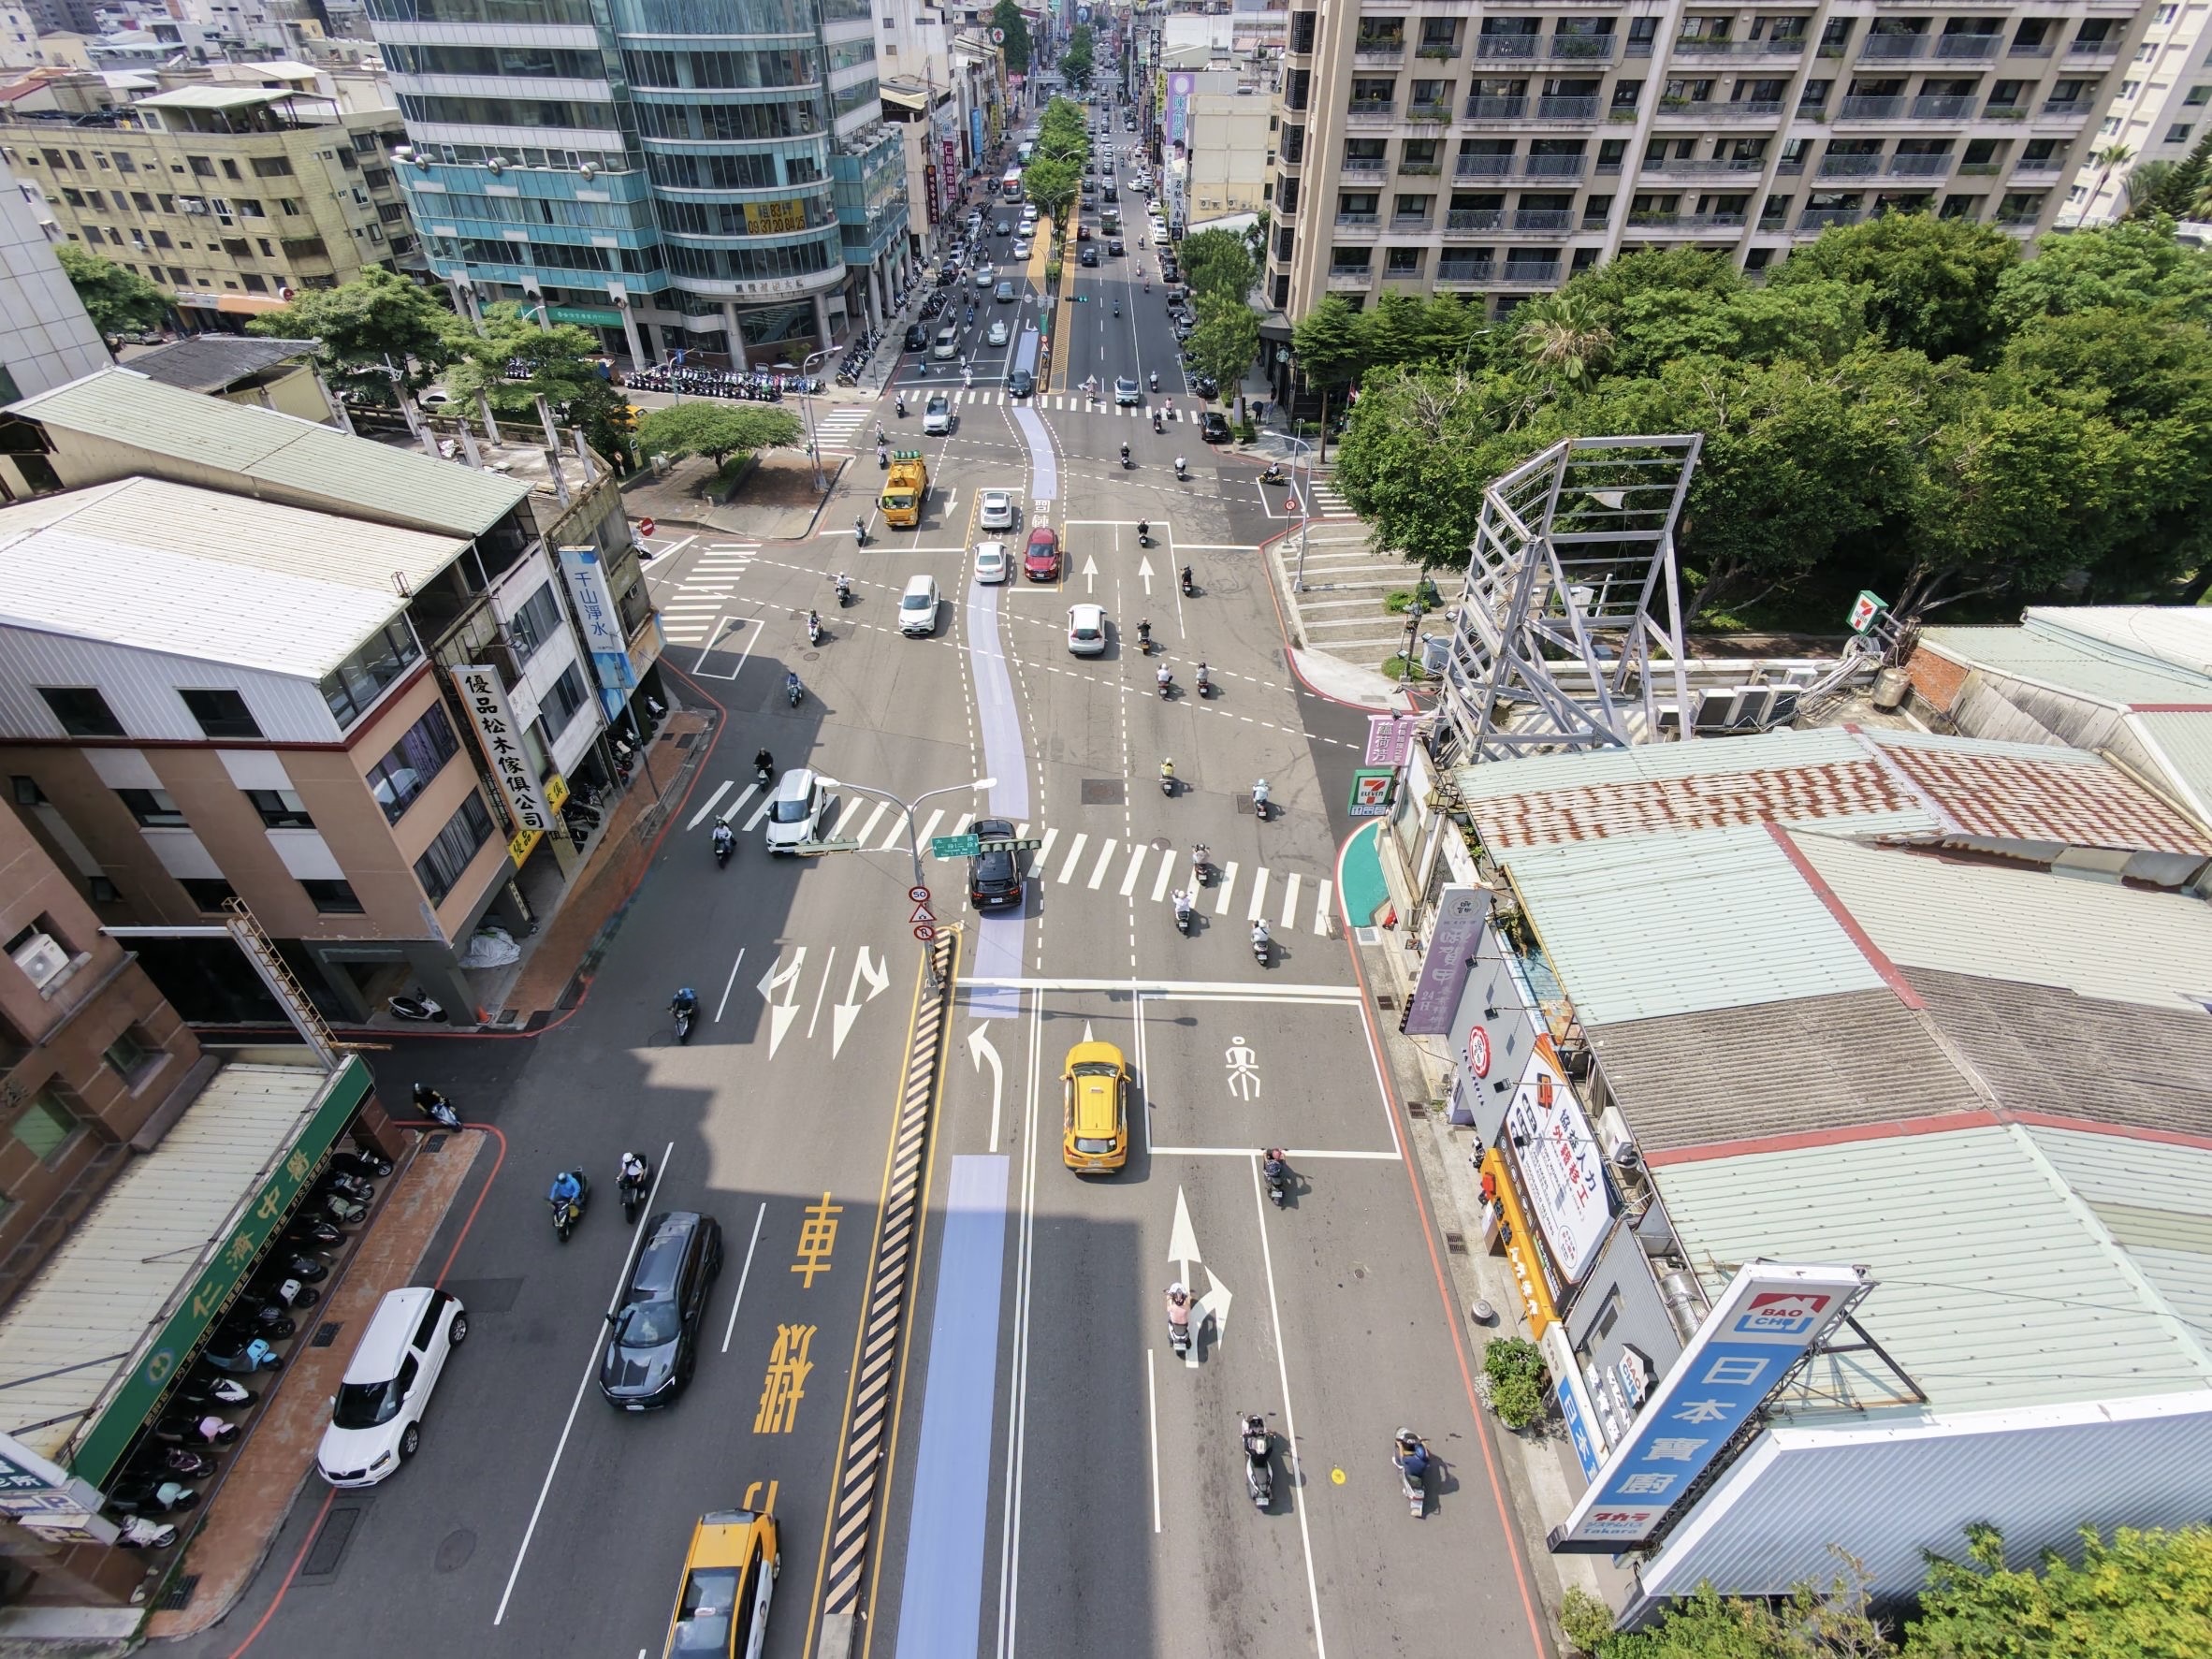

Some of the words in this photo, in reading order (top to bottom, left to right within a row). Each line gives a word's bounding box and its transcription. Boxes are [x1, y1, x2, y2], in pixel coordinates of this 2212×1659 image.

[573, 570, 609, 637] 千山淨水
[1551, 1125, 1590, 1208] 外籍移工
[1559, 1107, 1597, 1192] 協益人力
[192, 1150, 313, 1320] 仁濟中醫
[1761, 1308, 1803, 1317] BAO
[1626, 1355, 1641, 1390] BAO
[1615, 1357, 1770, 1495] 日本寶廚
[1593, 1512, 1652, 1521] タカラ
